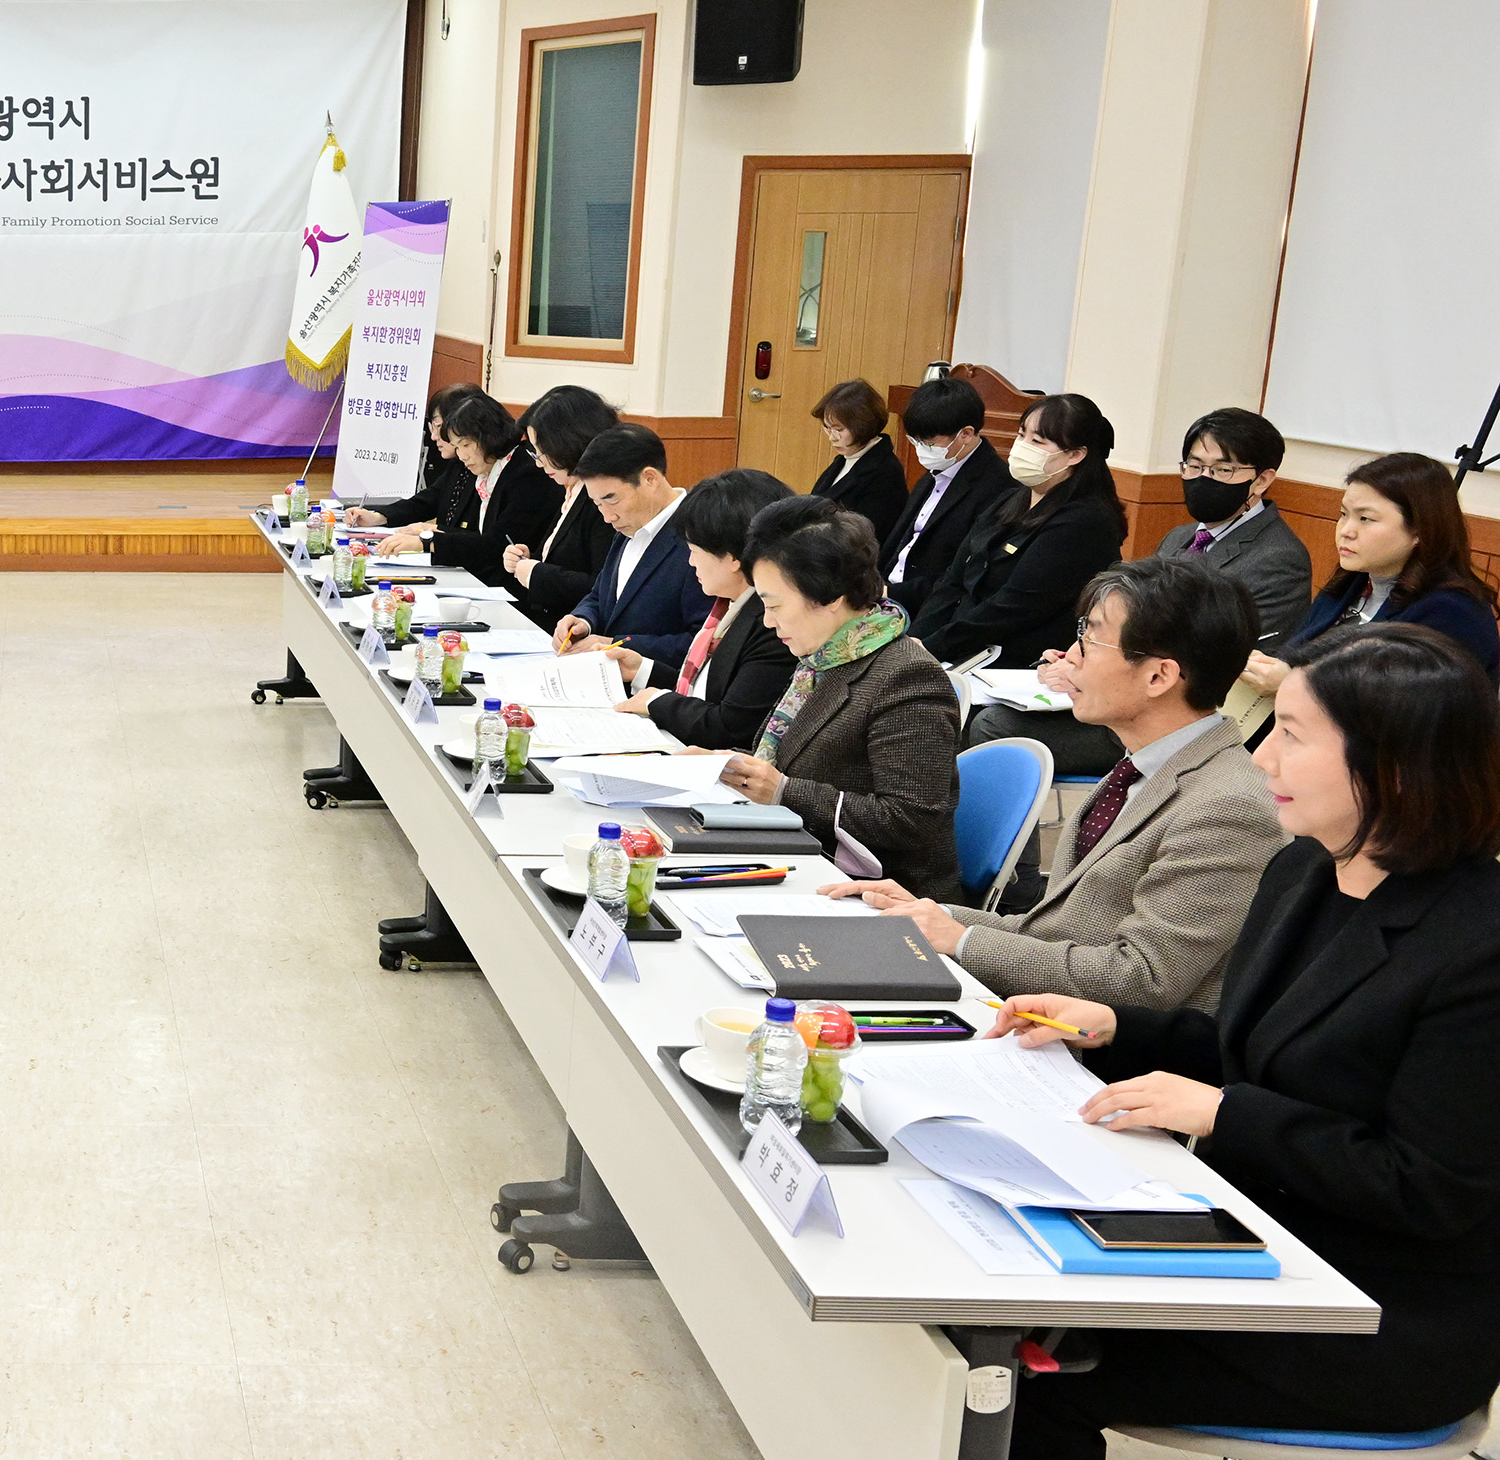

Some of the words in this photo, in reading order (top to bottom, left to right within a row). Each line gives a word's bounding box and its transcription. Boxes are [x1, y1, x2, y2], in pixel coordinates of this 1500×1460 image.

[2, 216, 48, 229] Family
[51, 216, 122, 227] Promotion
[125, 215, 166, 226] Social
[169, 215, 219, 225] Service
[367, 288, 426, 308] 울산광역시의회
[299, 295, 332, 340] 울산광역시
[362, 326, 422, 345] 복지환경위원회
[366, 363, 409, 382] 복지진흥원
[347, 398, 372, 416] 방문을
[374, 400, 419, 420] 환영합니다.
[354, 449, 372, 460] 2023.
